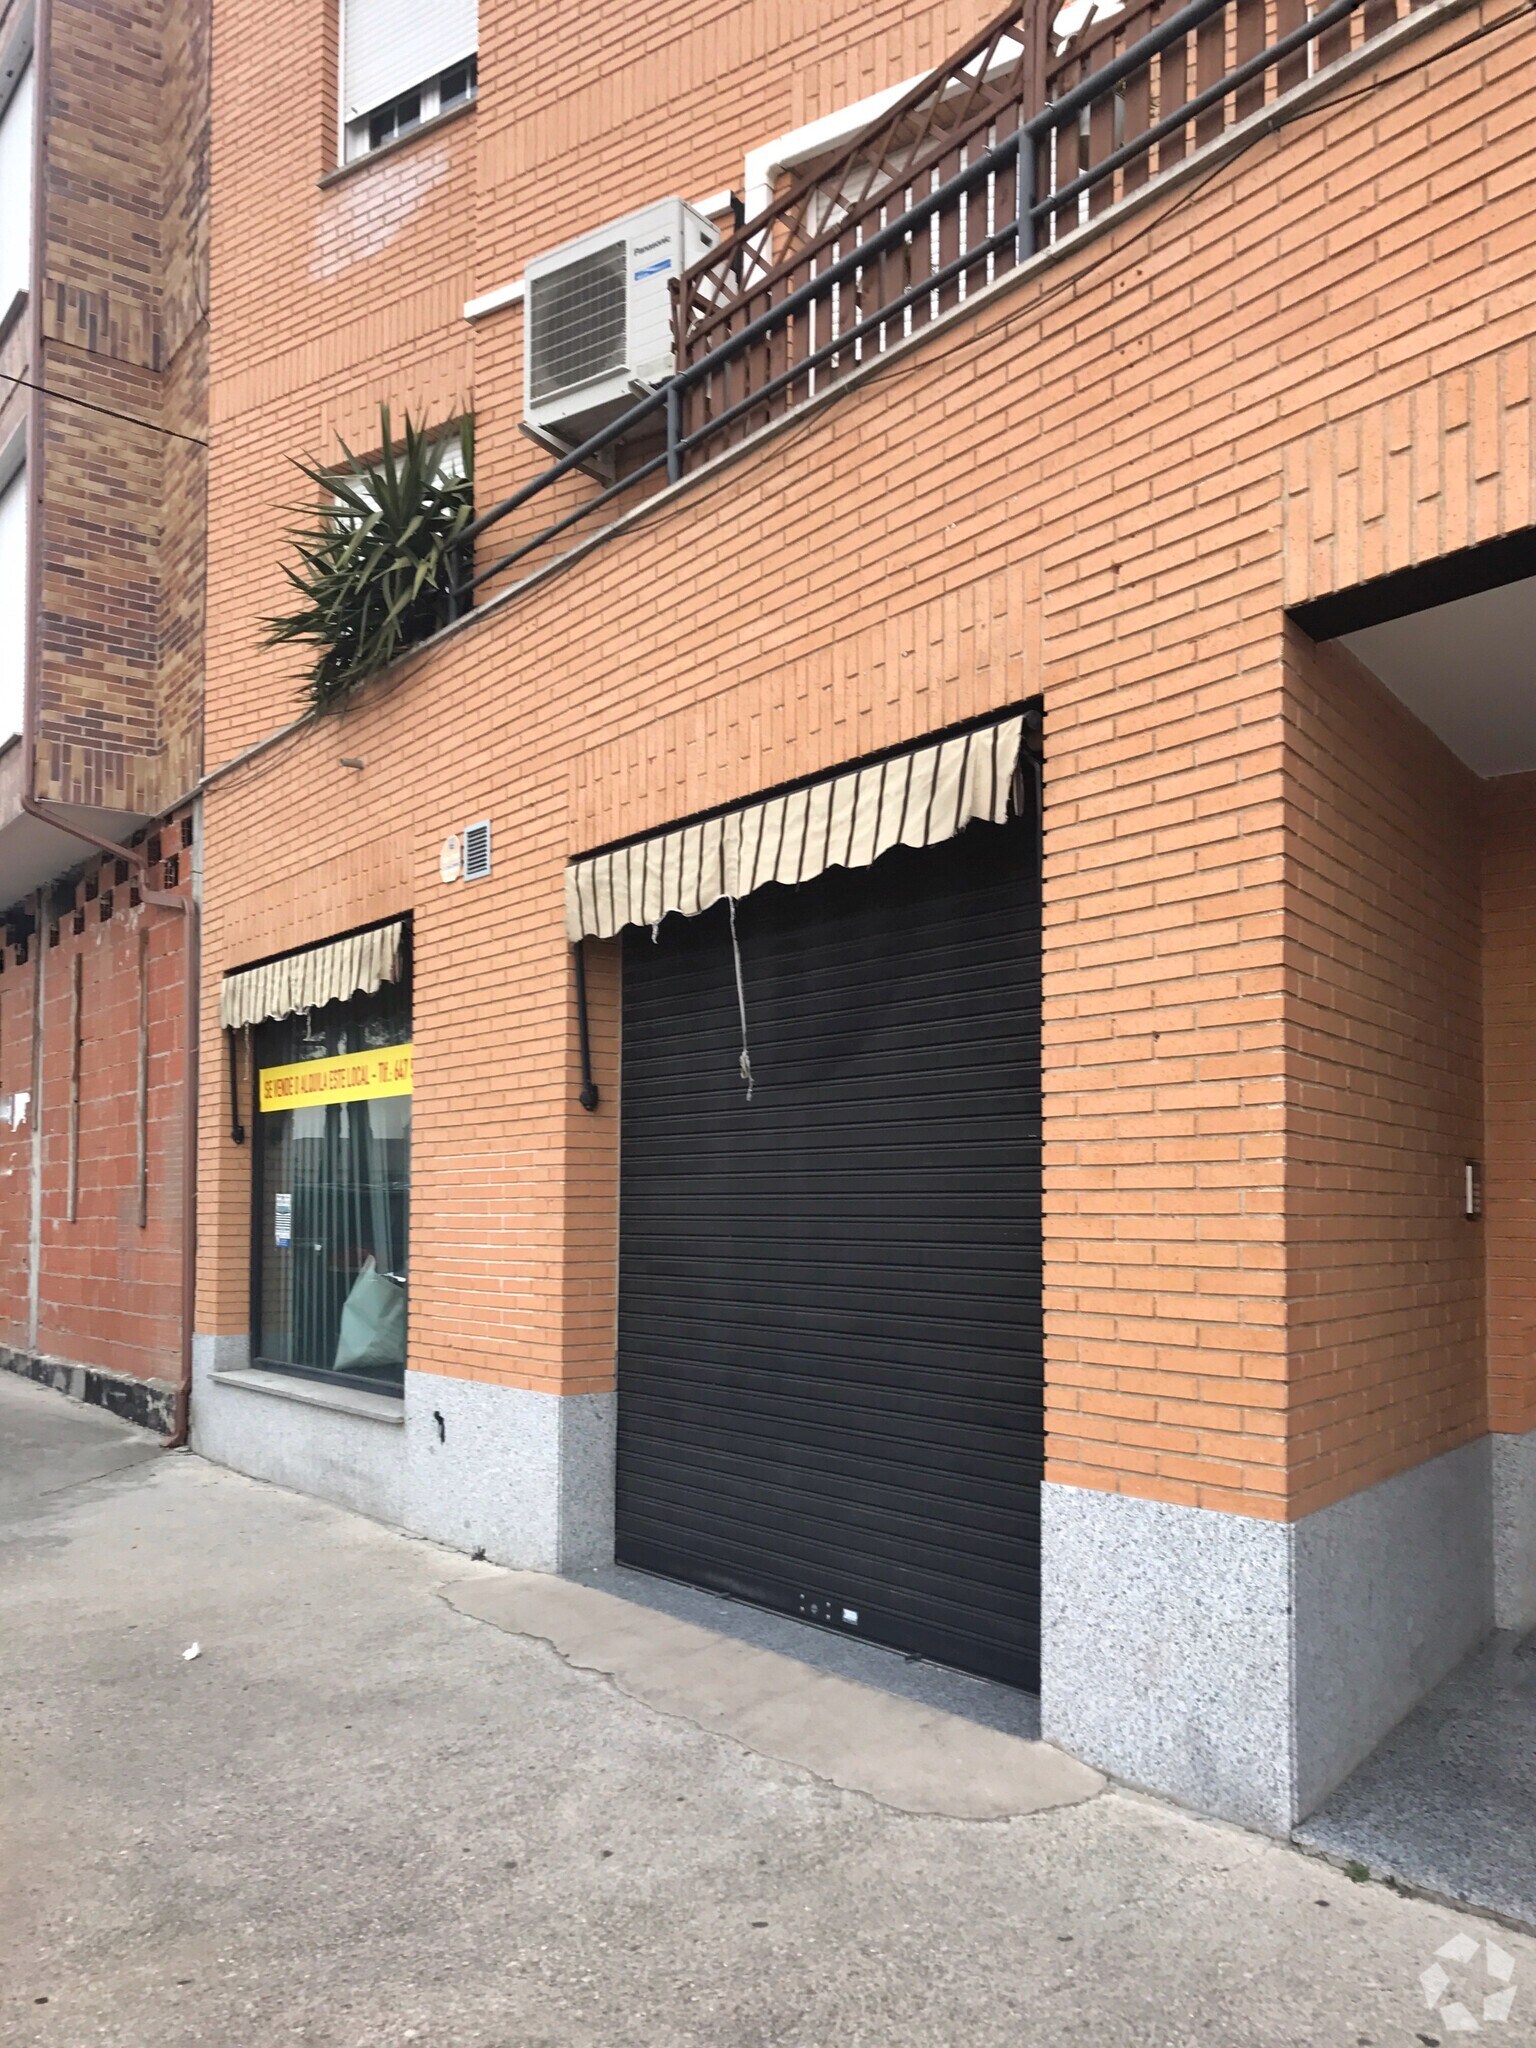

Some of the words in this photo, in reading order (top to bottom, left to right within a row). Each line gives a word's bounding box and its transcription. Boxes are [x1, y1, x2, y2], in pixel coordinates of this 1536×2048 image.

[634, 234, 671, 256] Panasonic
[264, 1080, 273, 1099] SE
[273, 1077, 294, 1098] VENDE
[300, 1071, 327, 1094] ALQUILA
[329, 1068, 346, 1090] ESTE
[347, 1064, 370, 1087] LOCAL
